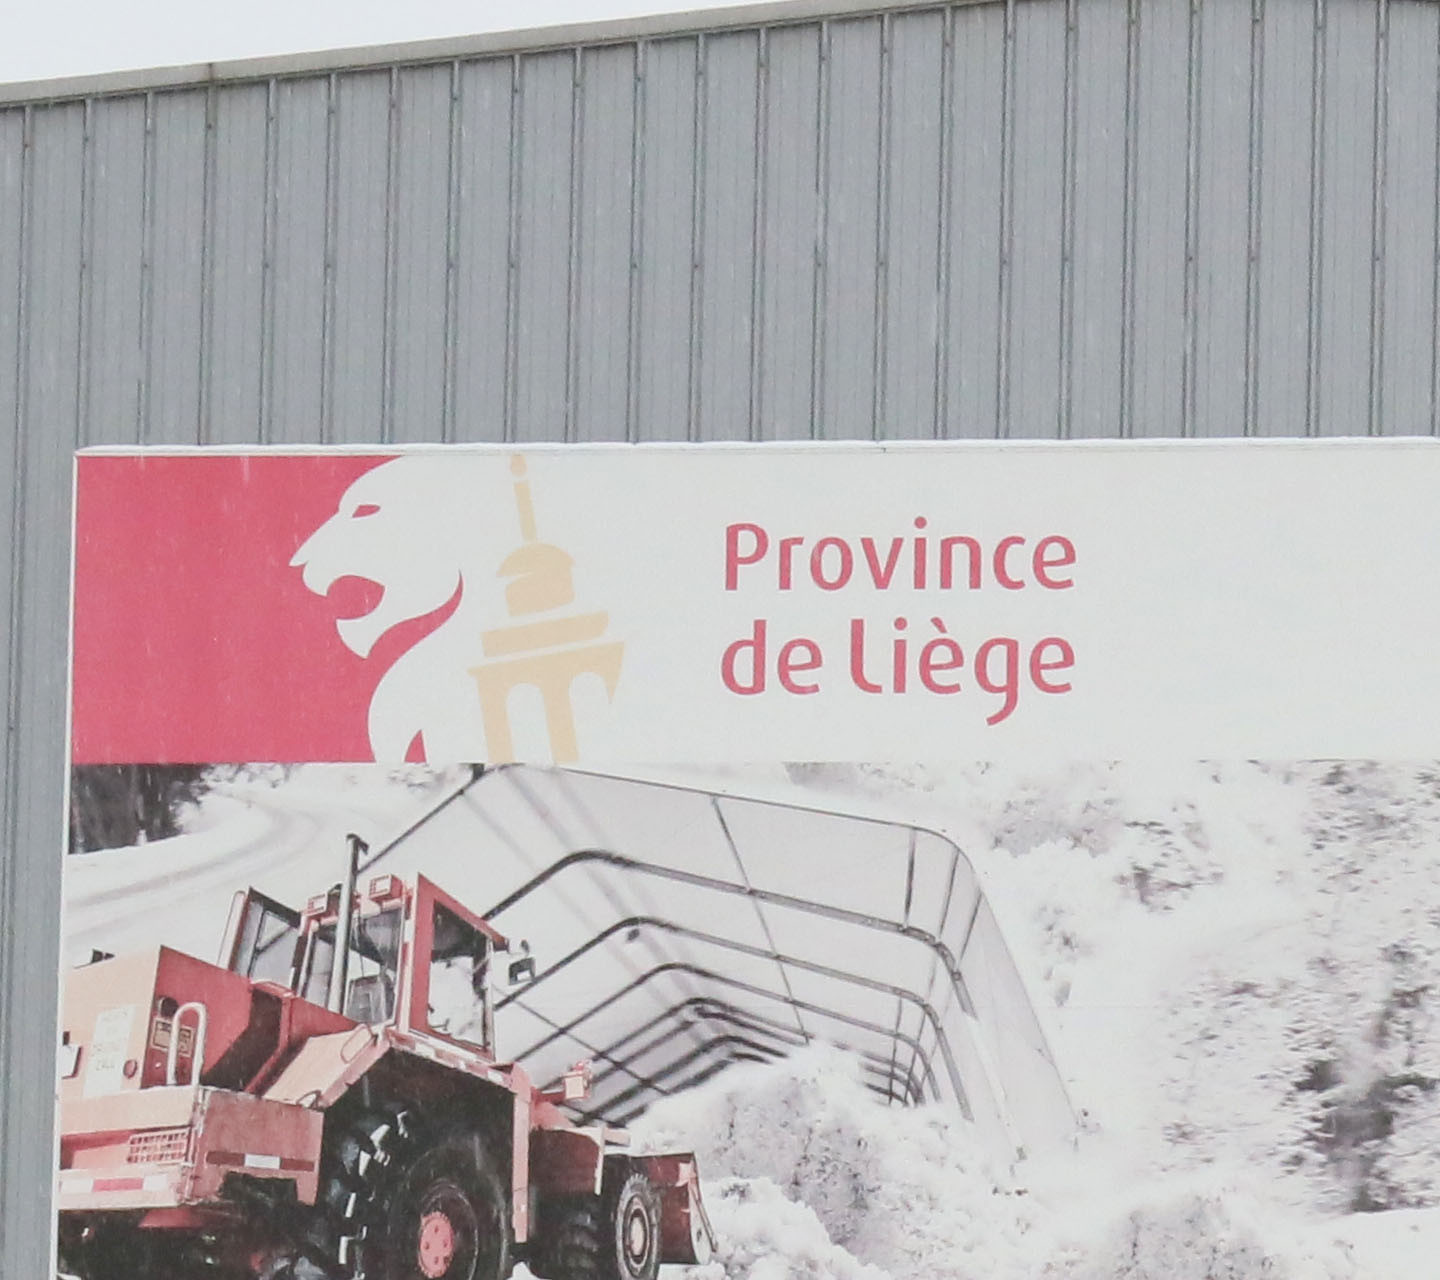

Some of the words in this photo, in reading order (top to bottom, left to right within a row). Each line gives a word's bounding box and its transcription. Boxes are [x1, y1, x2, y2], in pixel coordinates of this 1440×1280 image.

[726, 517, 1076, 591] Province
[722, 619, 822, 695] de
[851, 617, 1075, 725] Liège
